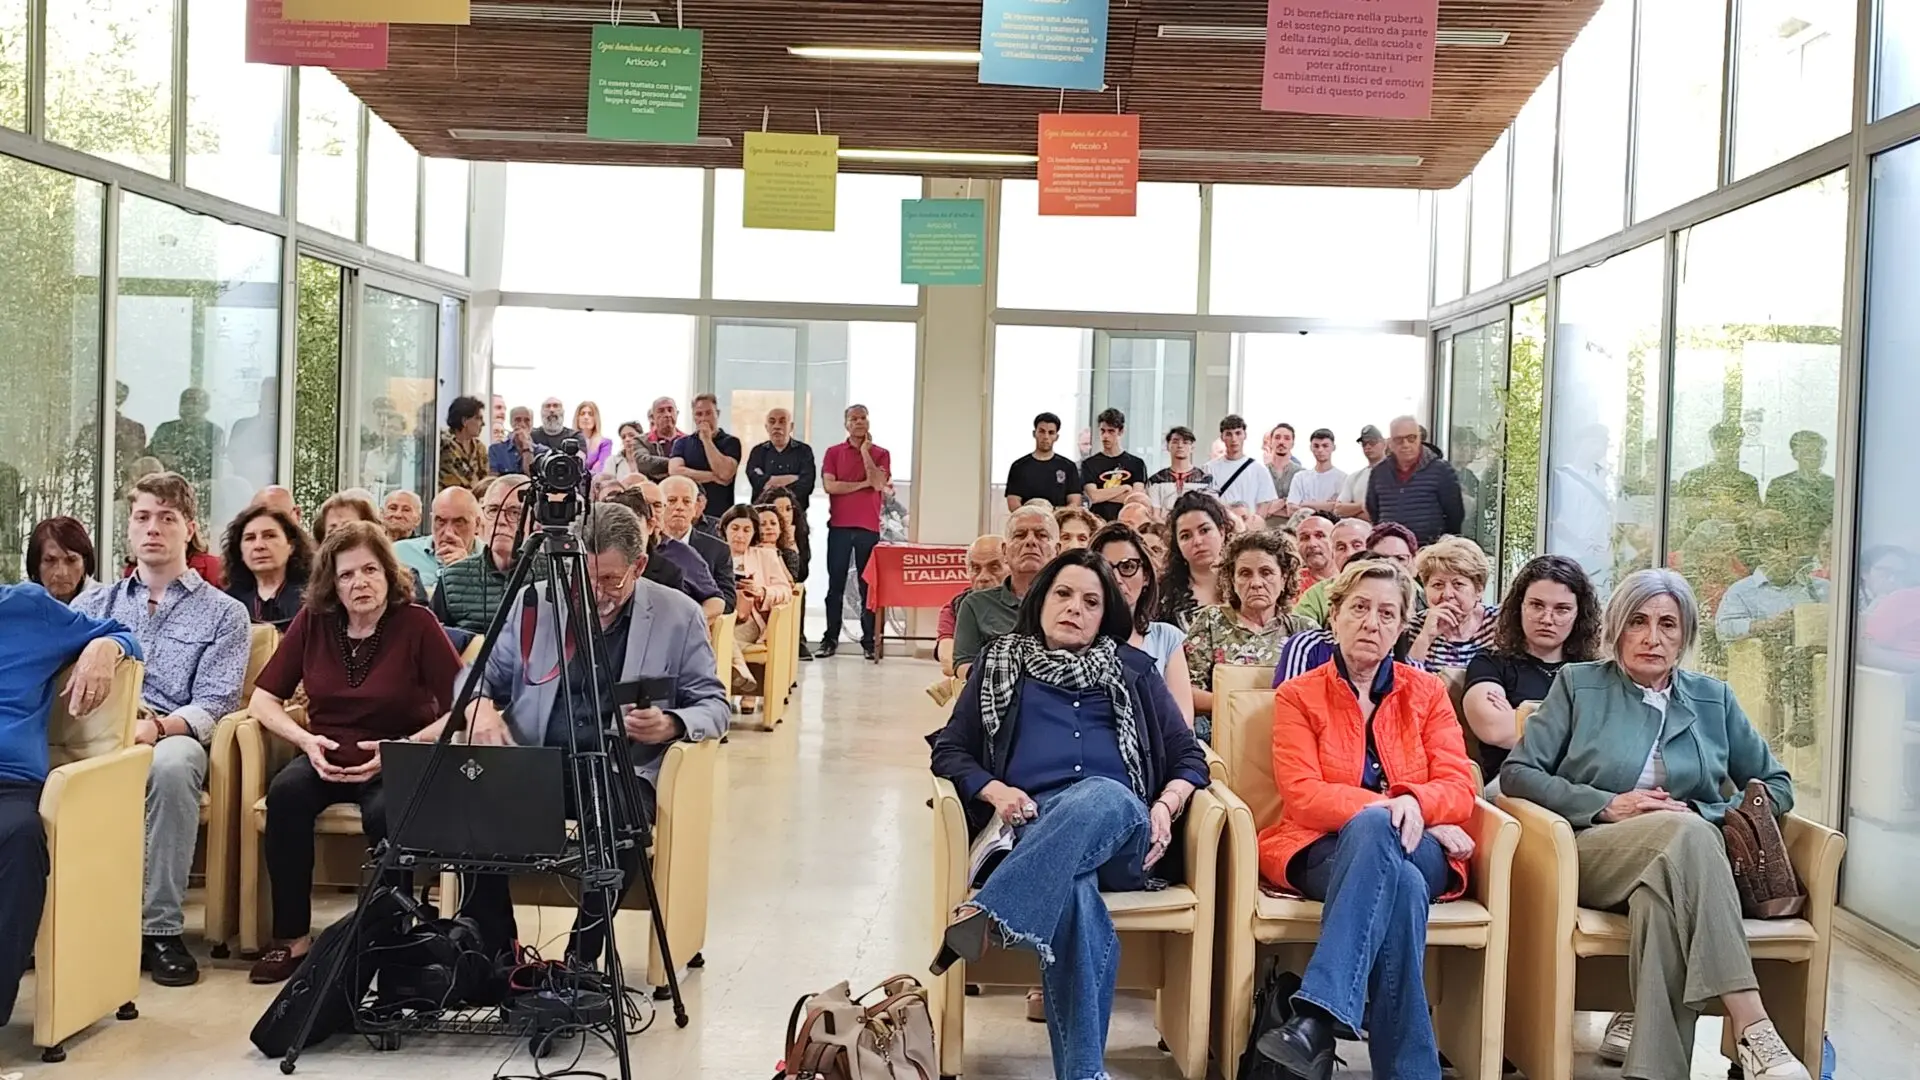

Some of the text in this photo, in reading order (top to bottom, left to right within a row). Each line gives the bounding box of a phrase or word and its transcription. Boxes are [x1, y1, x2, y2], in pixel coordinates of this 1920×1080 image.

[1283, 7, 1424, 25] Di beneficiare nella pubertà
[1277, 20, 1429, 40] del sostegno positivo da parte
[1280, 32, 1423, 50] della famiglia, della scuola e
[1278, 45, 1424, 64] dei servizi socio-sanitari per
[624, 57, 667, 67] Articolo 4
[1306, 60, 1333, 72] poter
[1335, 62, 1387, 73] affrontare
[1272, 71, 1425, 88] cambiamenti fisici ed emotivi
[641, 91, 669, 99] persona
[1287, 84, 1315, 96] tipici
[1316, 85, 1327, 95] di
[1328, 87, 1364, 98] questo
[1070, 142, 1109, 151] Articolo 3
[903, 553, 967, 565] SINISTR
[904, 569, 970, 581] ITALIAN
